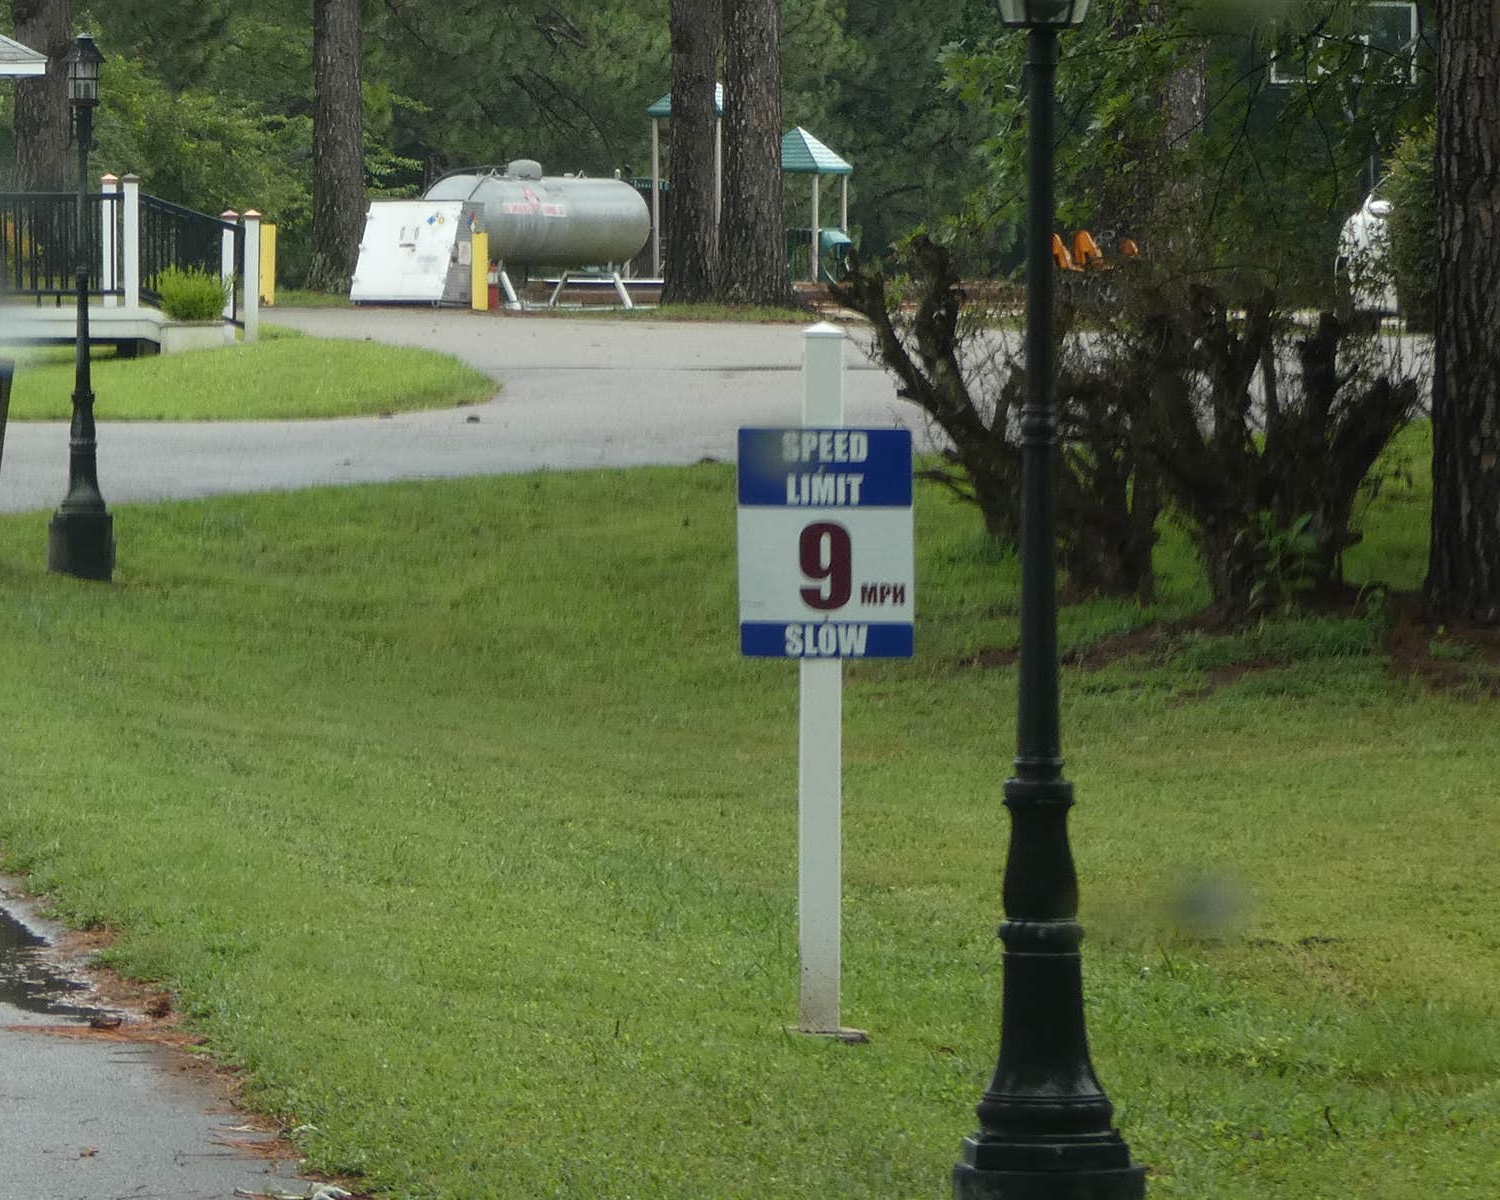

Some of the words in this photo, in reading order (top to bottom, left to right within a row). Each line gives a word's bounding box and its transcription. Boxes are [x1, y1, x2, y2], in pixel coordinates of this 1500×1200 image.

[781, 431, 868, 463] SPEED
[786, 473, 864, 505] LIMIT
[799, 522, 852, 610] 9
[861, 583, 906, 606] MPH
[785, 623, 868, 656] SLOW
